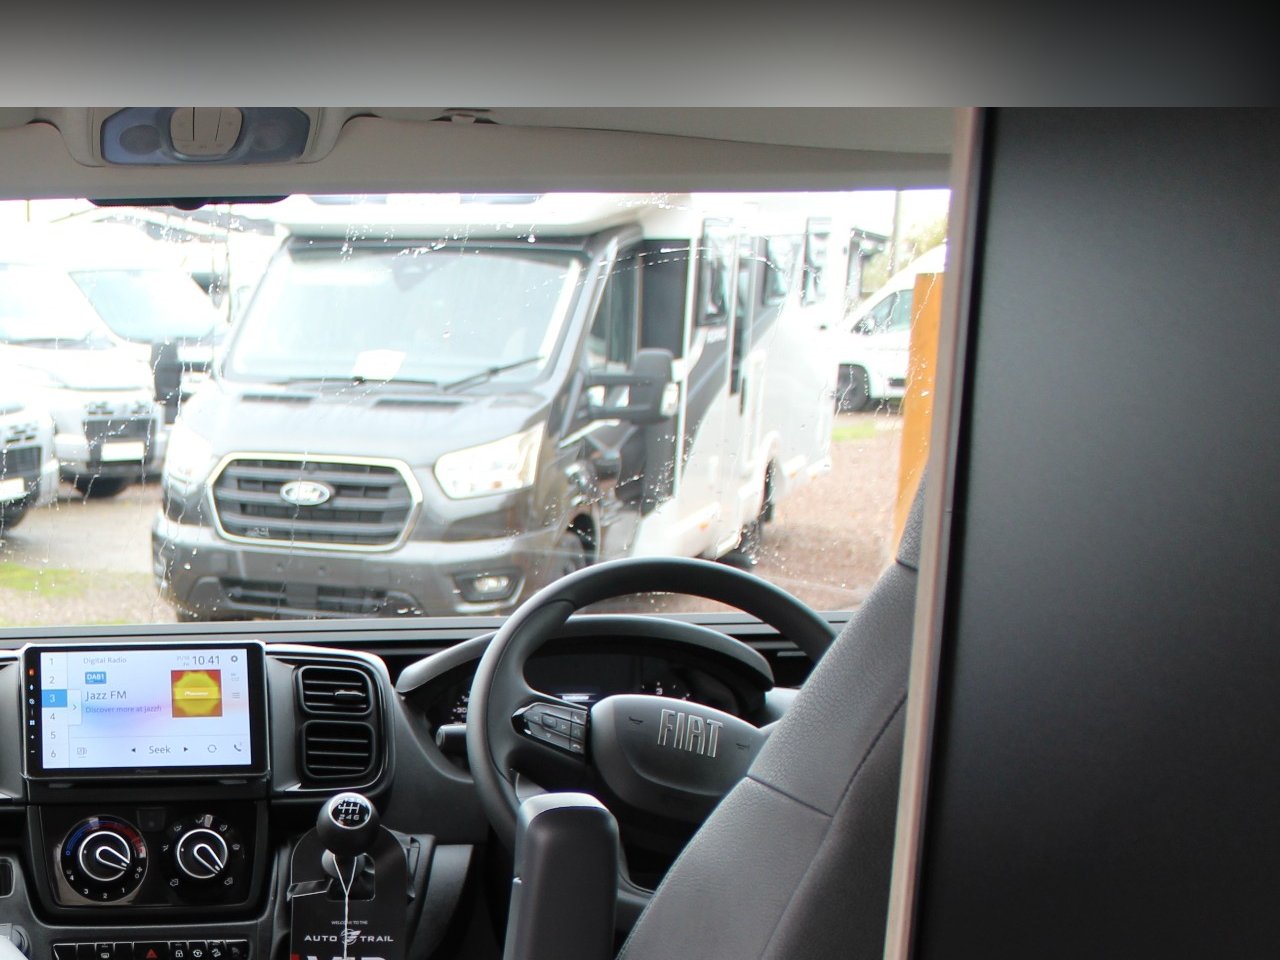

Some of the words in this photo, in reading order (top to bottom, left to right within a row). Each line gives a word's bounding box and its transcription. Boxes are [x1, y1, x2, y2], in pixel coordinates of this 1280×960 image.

[83, 656, 106, 666] Digital
[107, 656, 127, 664] Radio
[86, 691, 107, 702] Jazz
[110, 690, 127, 700] FM
[658, 709, 723, 757] FIAT
[148, 744, 171, 754] Seek
[304, 934, 338, 942] AUTO
